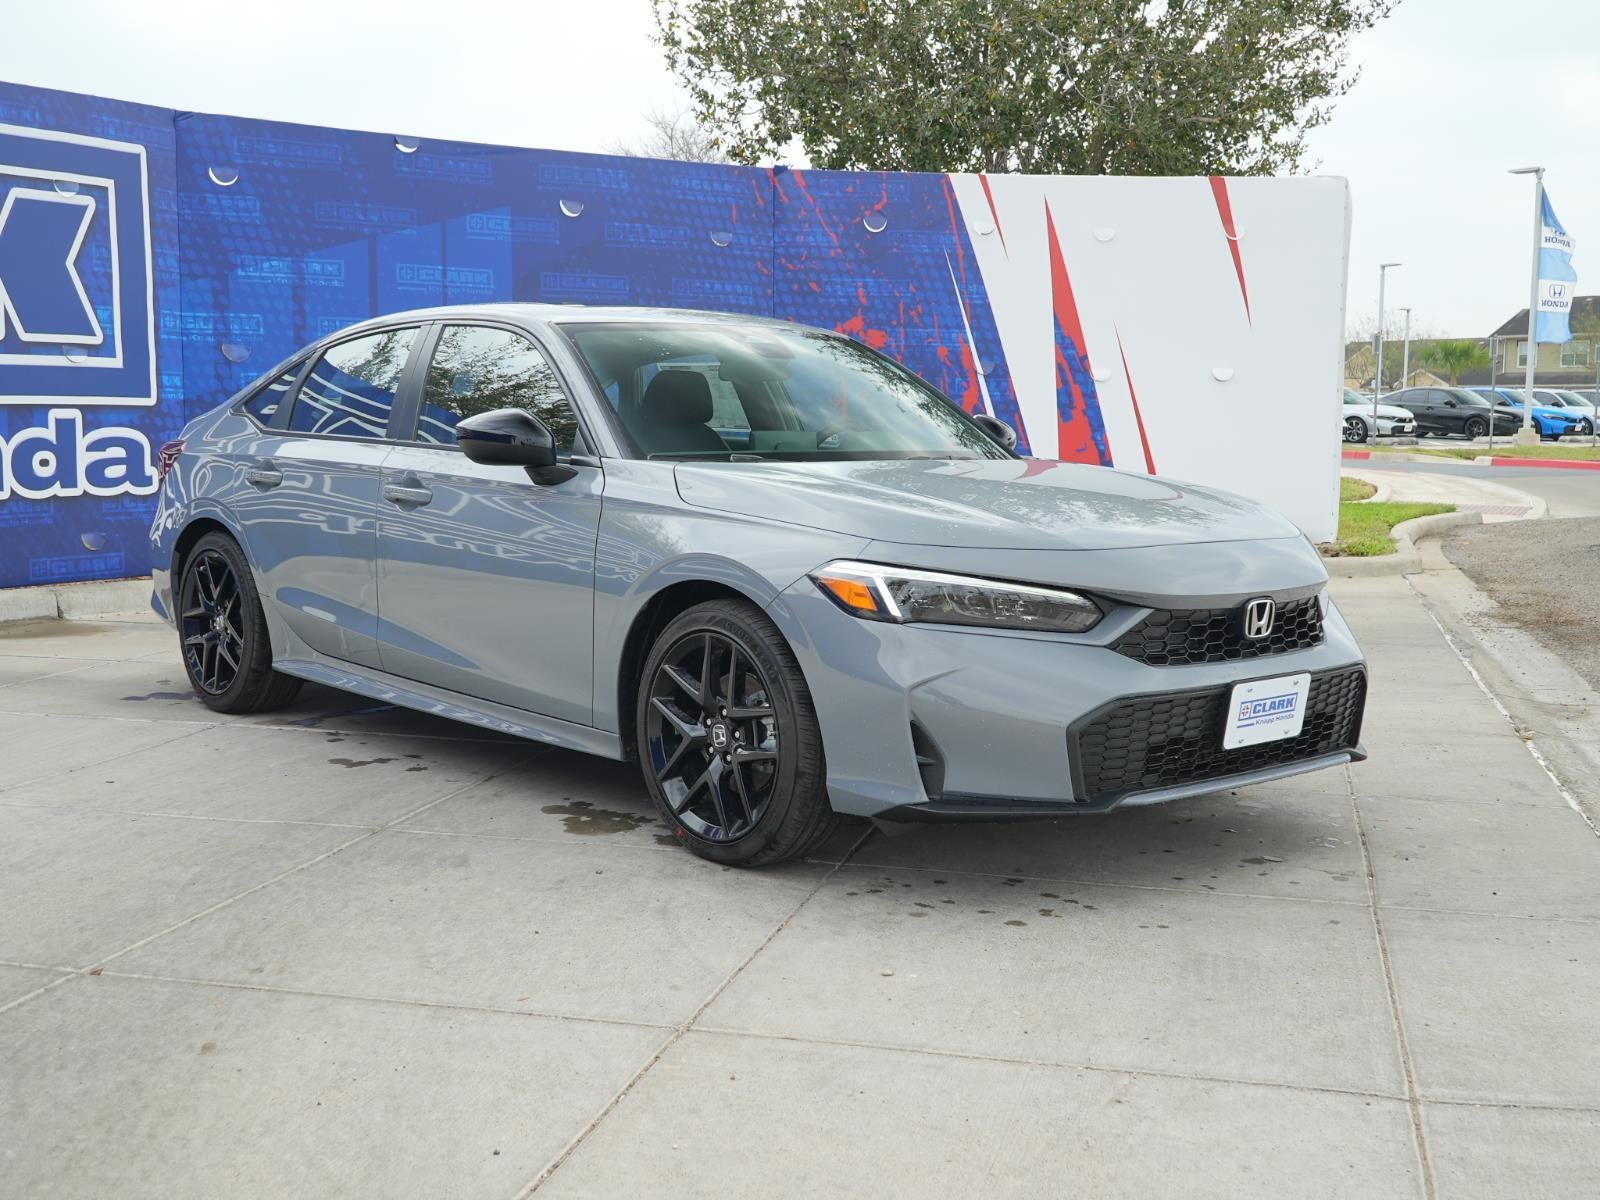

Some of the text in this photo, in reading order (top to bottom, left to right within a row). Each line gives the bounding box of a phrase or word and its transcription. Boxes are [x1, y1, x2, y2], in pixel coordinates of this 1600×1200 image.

[0, 408, 158, 500] da
[1253, 697, 1294, 714] CLARK
[1276, 713, 1294, 721] Honda
